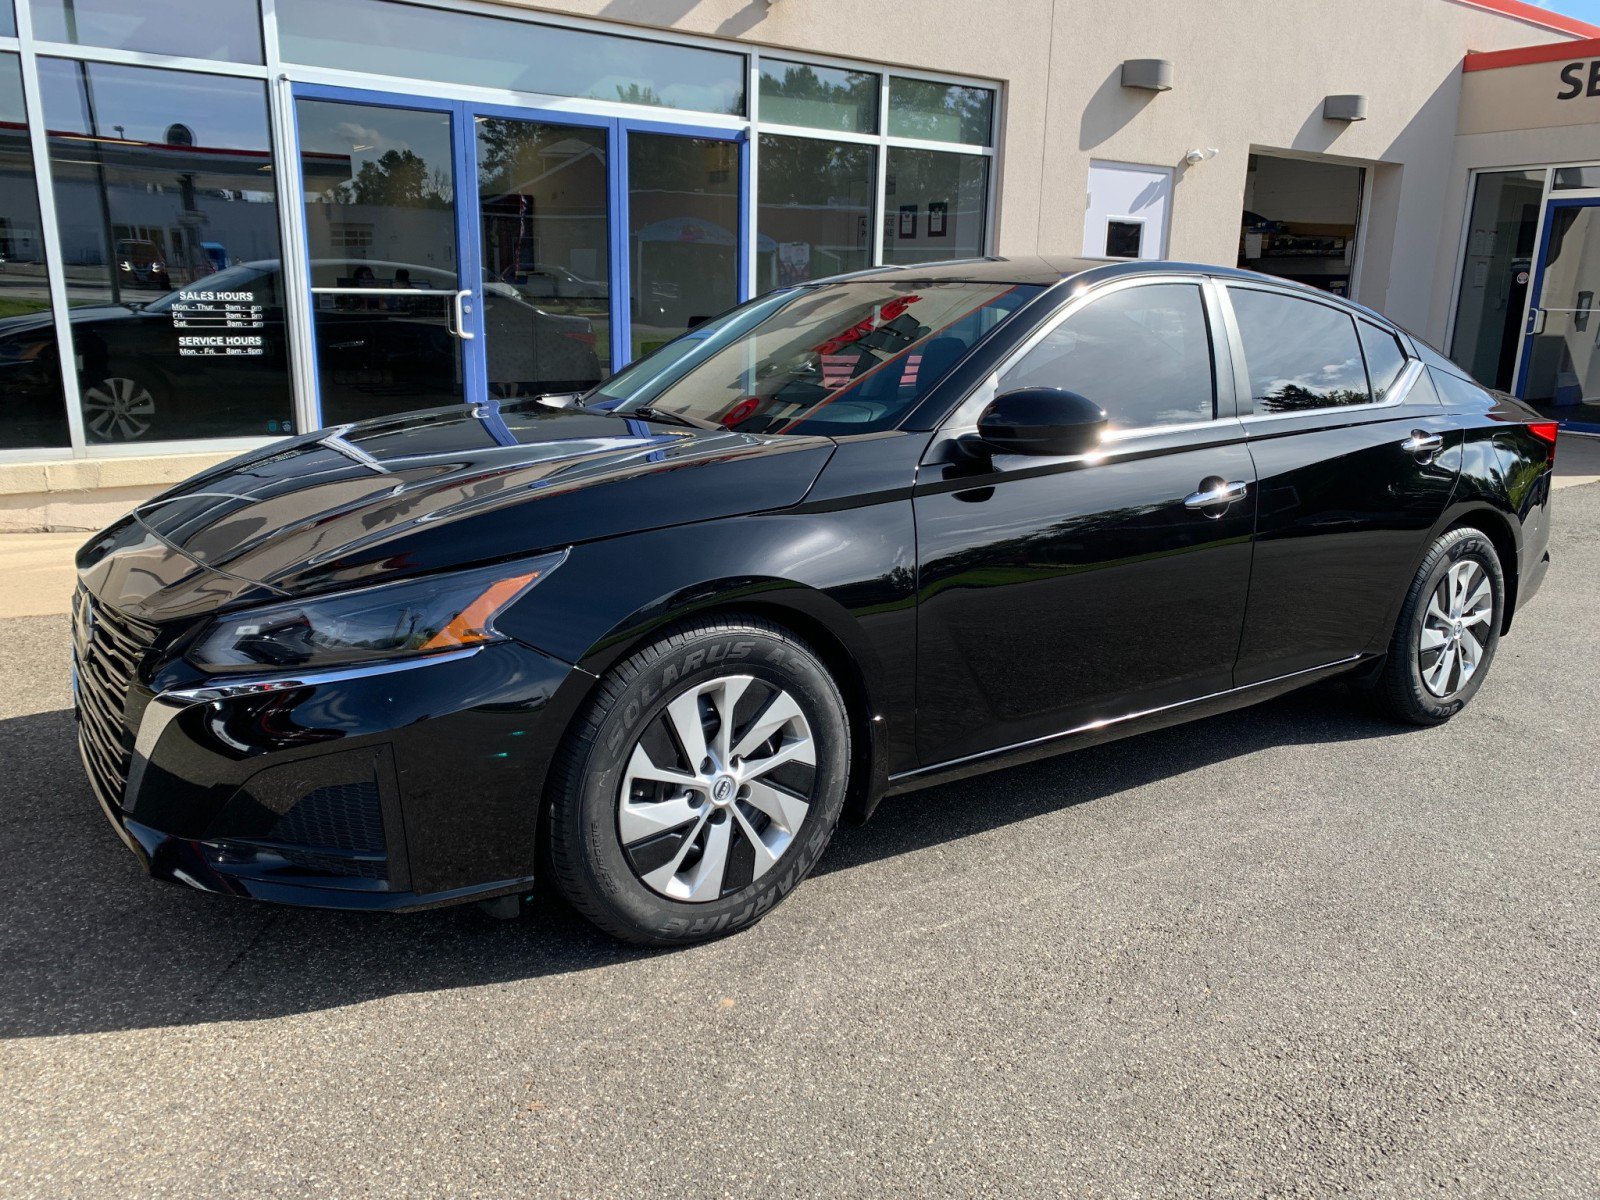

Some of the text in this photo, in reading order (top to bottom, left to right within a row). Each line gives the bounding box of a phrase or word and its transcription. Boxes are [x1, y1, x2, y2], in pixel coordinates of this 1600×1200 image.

[1557, 61, 1600, 100] SE
[179, 292, 253, 300] SALES HOURS
[178, 337, 262, 345] SERVICE HOURS
[607, 641, 811, 759] SOLARUS AS
[659, 823, 826, 938] STARFIRE
